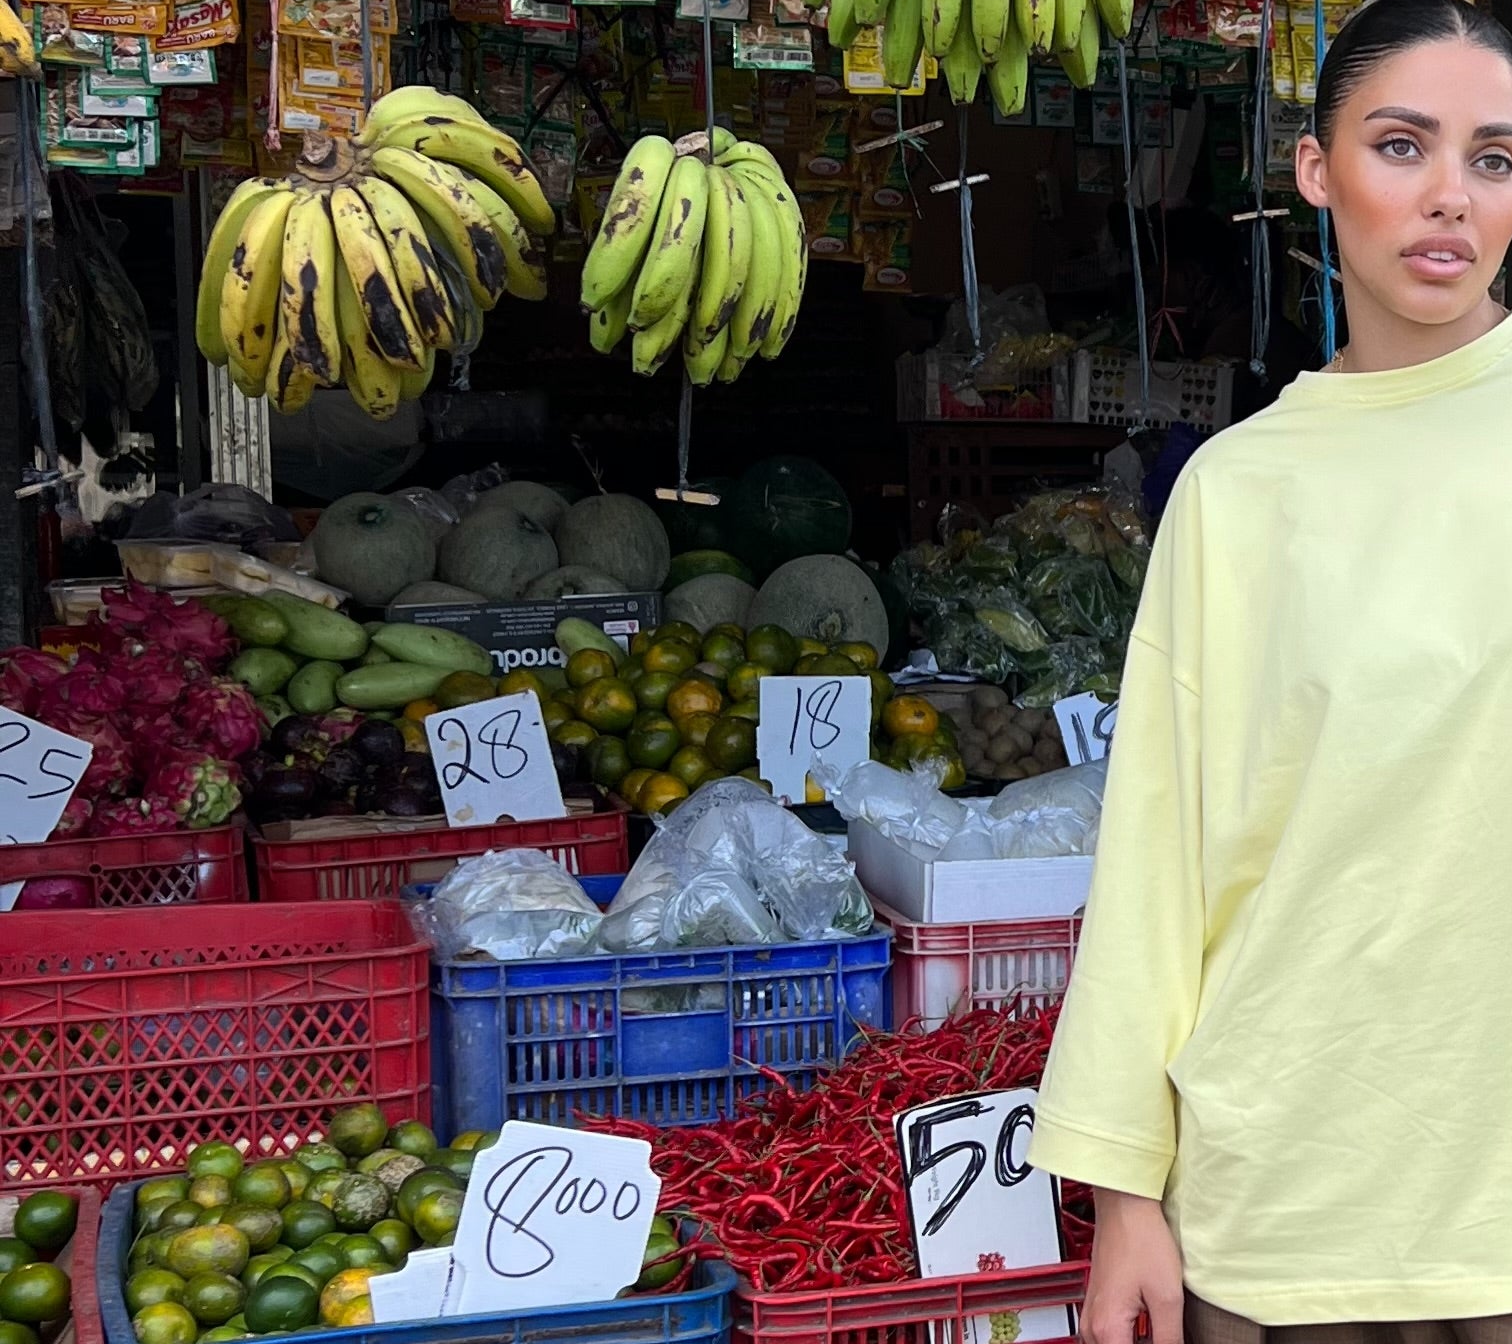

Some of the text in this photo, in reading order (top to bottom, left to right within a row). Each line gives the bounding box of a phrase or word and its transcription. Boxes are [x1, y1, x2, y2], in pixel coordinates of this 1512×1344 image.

[104, 16, 134, 25] BARU
[789, 680, 843, 755] 18
[484, 1145, 641, 1279] 8000
